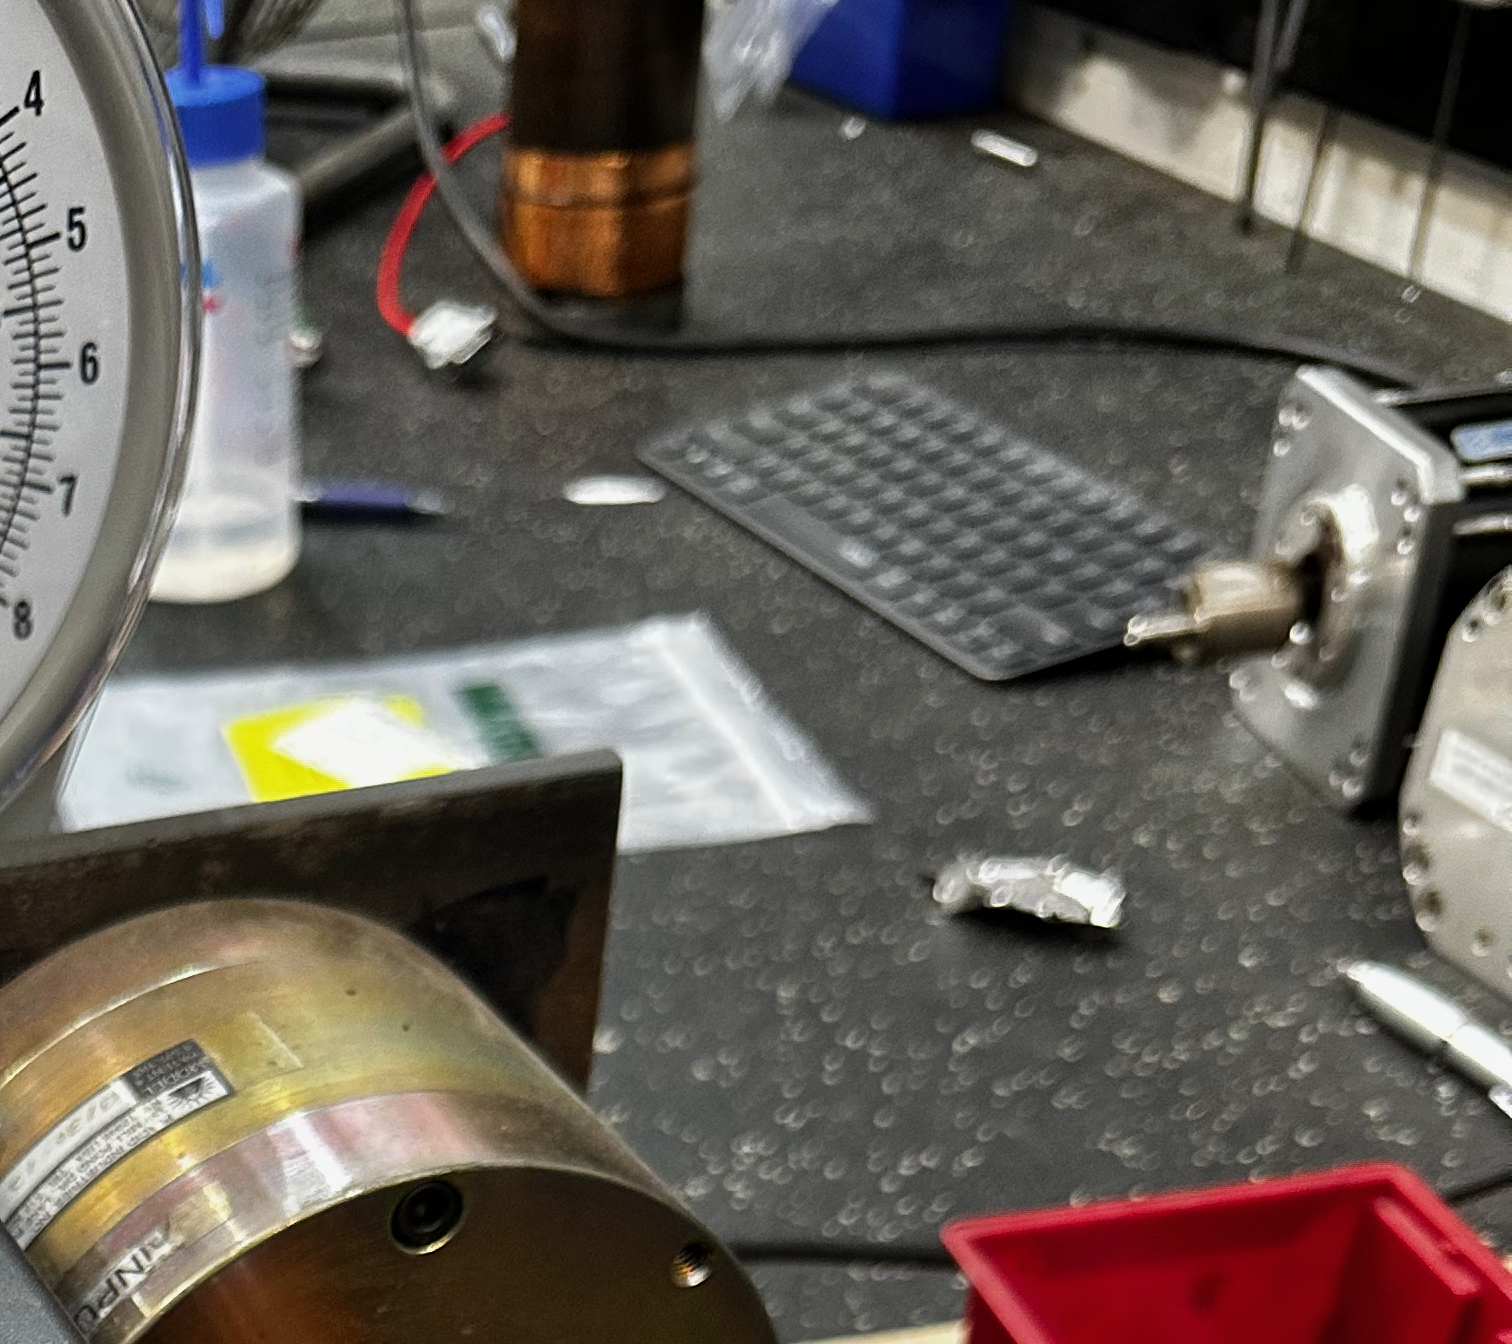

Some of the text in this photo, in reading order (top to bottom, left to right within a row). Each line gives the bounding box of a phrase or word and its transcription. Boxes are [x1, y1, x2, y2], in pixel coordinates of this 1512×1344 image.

[26, 71, 44, 116] 4
[66, 207, 86, 251] 5
[81, 343, 98, 384] 6
[57, 474, 77, 516] 7
[12, 601, 32, 639] 8
